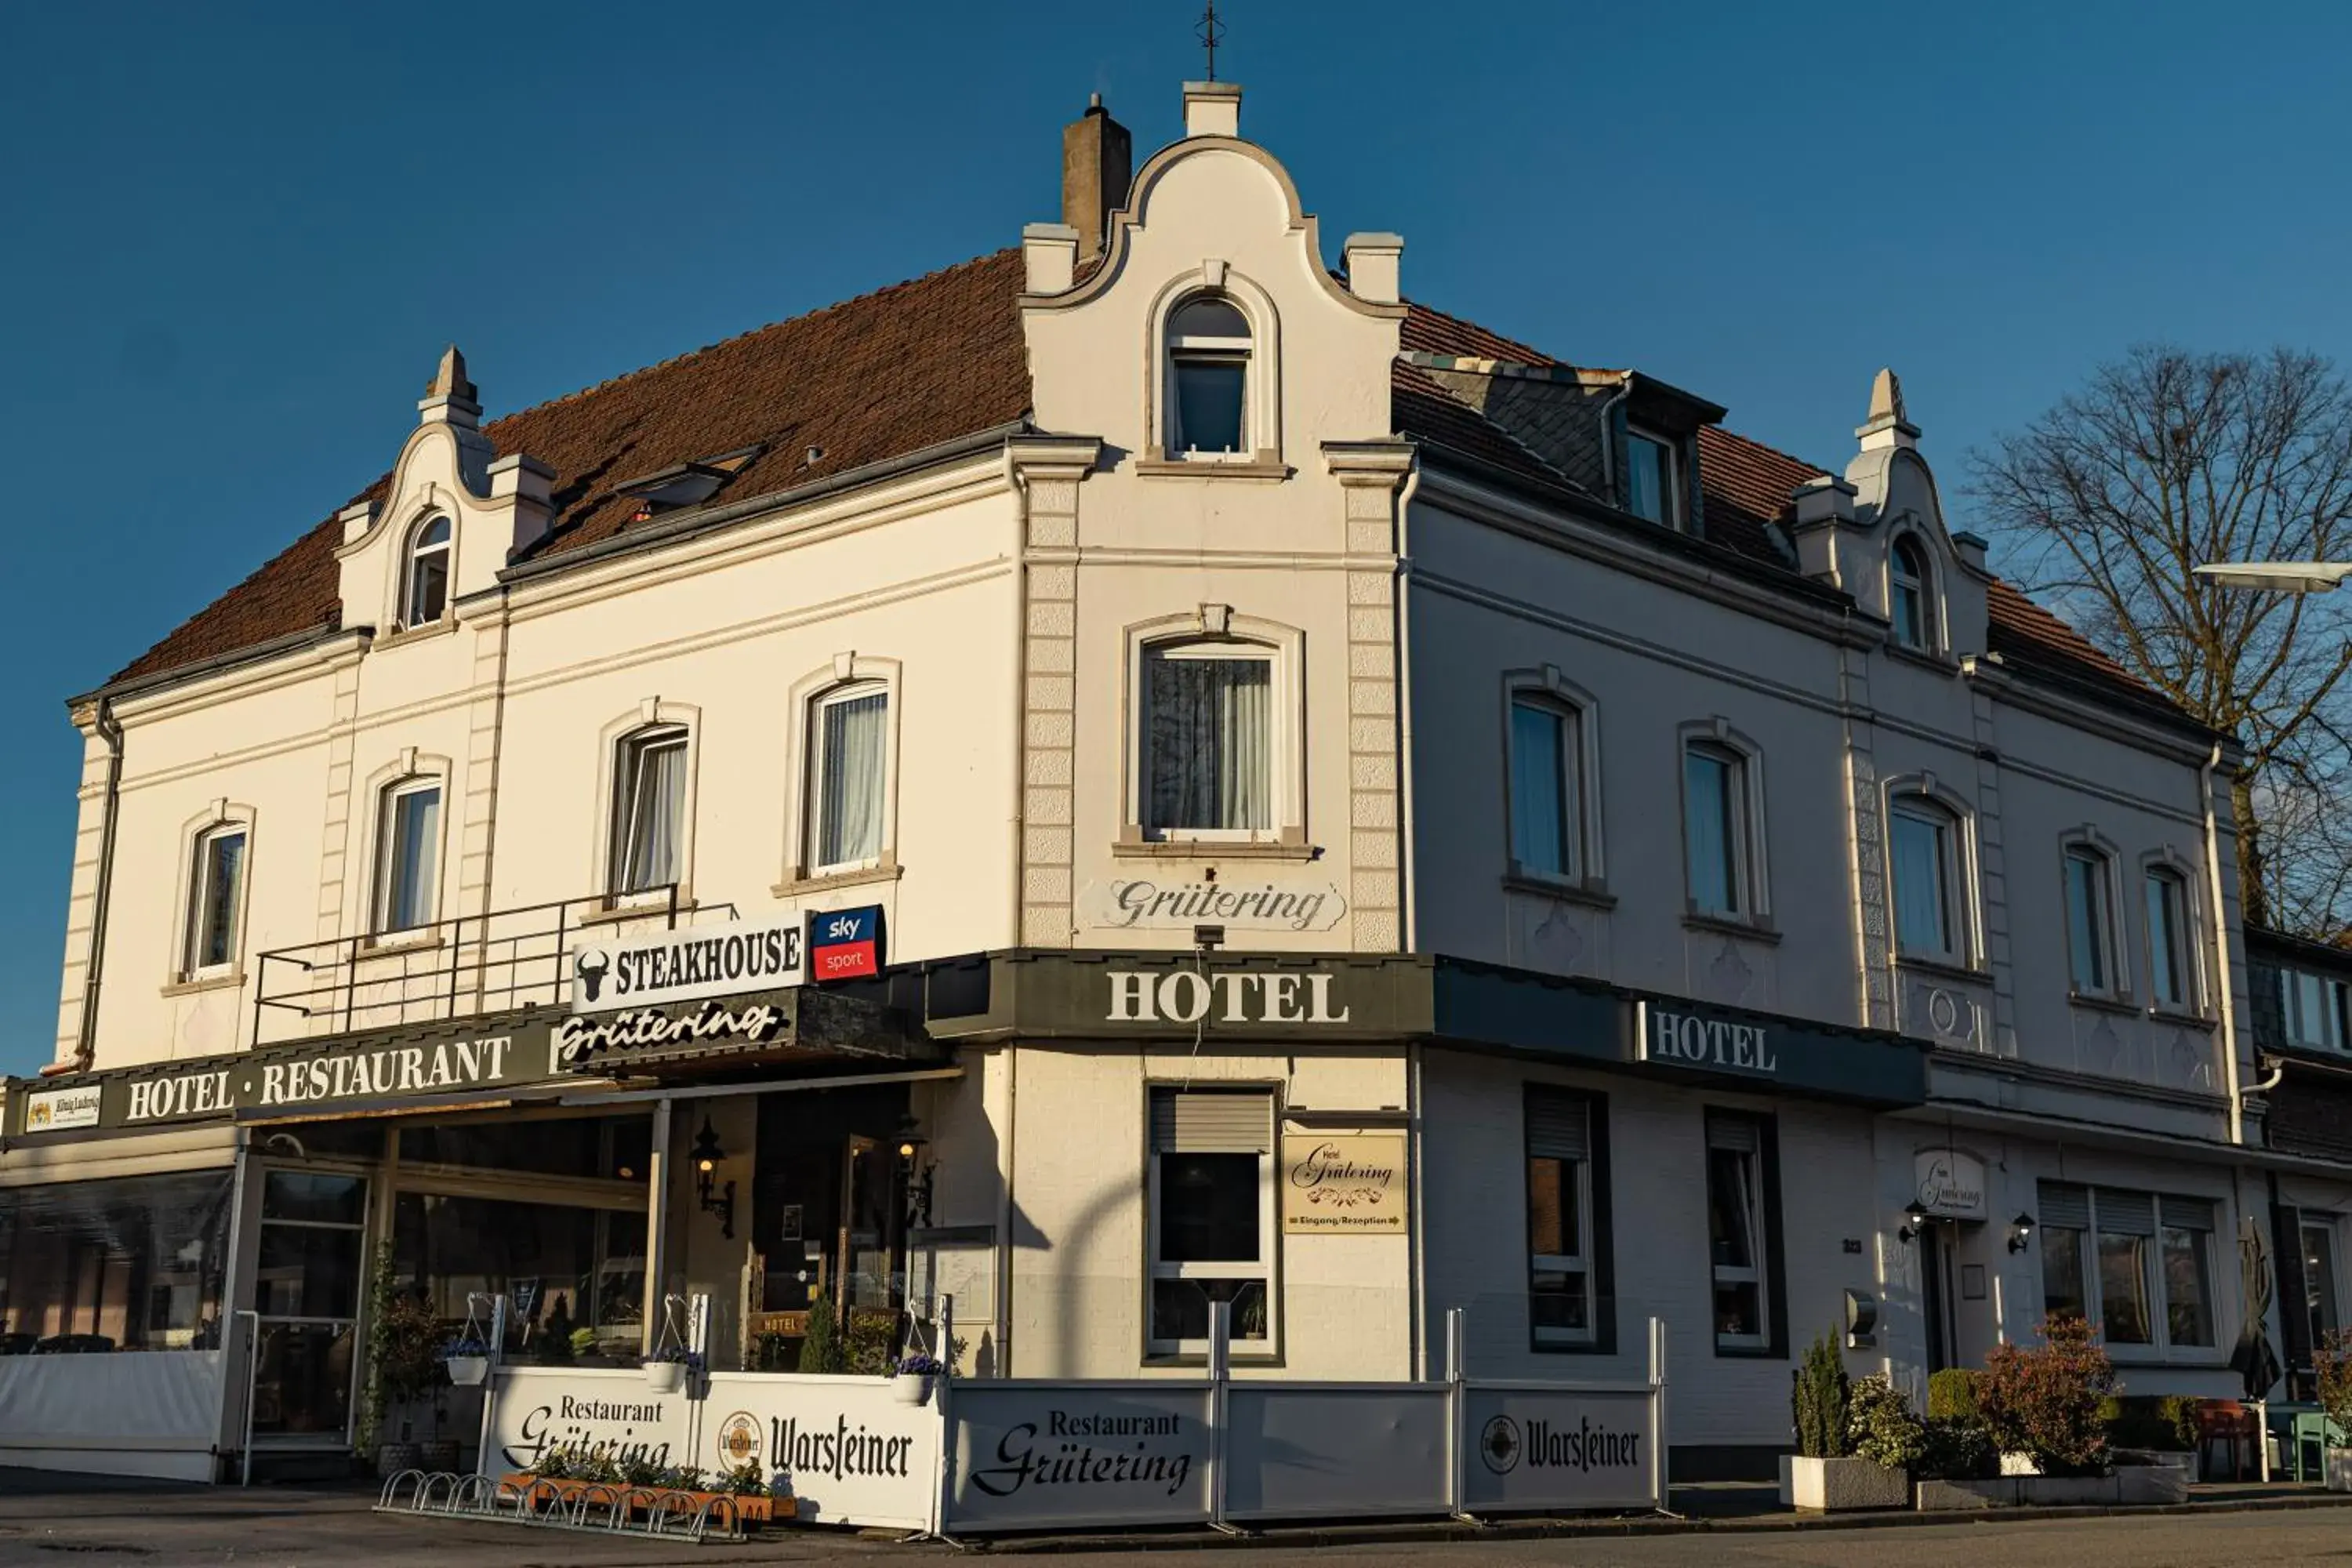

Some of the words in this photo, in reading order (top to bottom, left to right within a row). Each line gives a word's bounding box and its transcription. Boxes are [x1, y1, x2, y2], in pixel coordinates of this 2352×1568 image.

[829, 915, 861, 940] sky
[1108, 880, 1326, 931] Grütering
[615, 925, 801, 996] STEAKHOUSE
[826, 951, 864, 971] sport
[1105, 971, 1350, 1023] HOTEL
[557, 1000, 779, 1061] Grütering
[1653, 1011, 1777, 1073] HOTEL
[125, 1069, 237, 1121] HOTEL
[260, 1036, 512, 1105] RESTAURANT
[1291, 1142, 1393, 1189] Grütering
[764, 1317, 796, 1330] HOTEL
[561, 1395, 663, 1422] Restaurant
[1047, 1410, 1180, 1436] Restaurant
[769, 1414, 914, 1482] Warsteiner
[971, 1422, 1191, 1497] Grütering
[1526, 1415, 1640, 1474] Warsteiner
